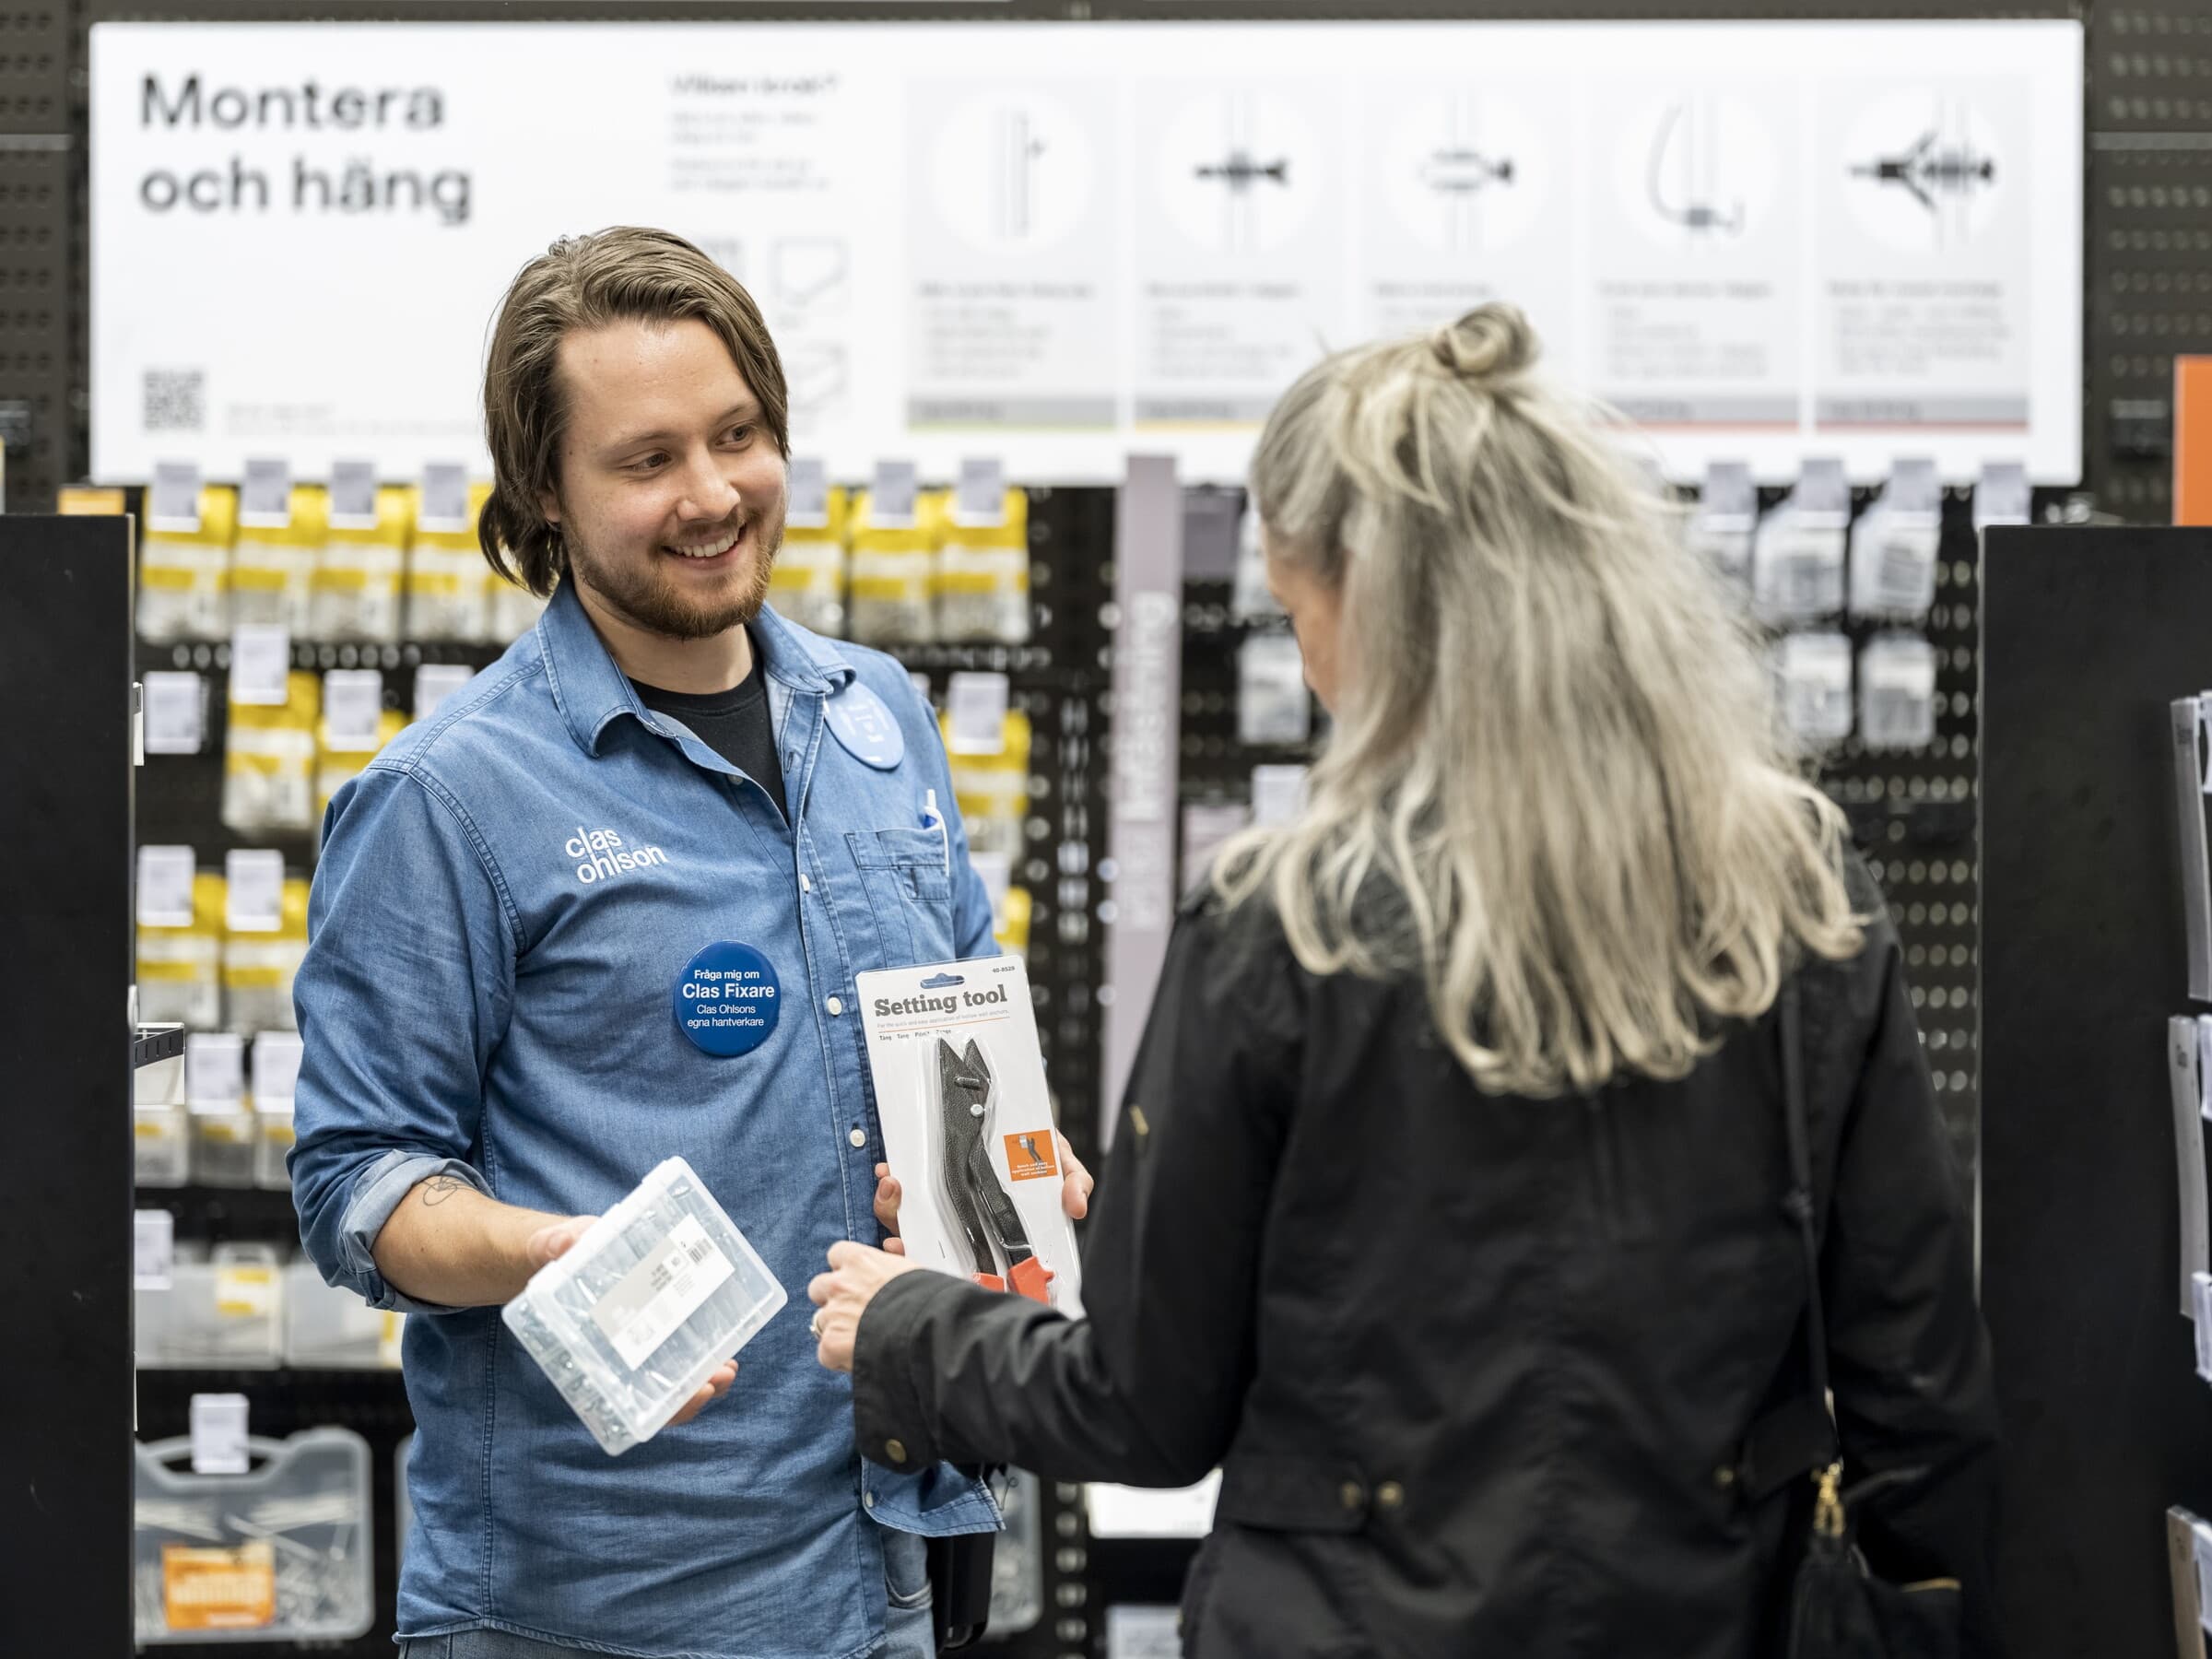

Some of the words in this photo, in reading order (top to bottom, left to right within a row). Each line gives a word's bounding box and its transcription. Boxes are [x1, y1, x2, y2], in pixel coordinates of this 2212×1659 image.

[141, 75, 444, 129] Montera
[140, 156, 269, 212] och
[292, 155, 470, 227] häng
[565, 826, 623, 858] clas
[577, 845, 669, 884] ohlson
[682, 983, 720, 998] Clas
[725, 983, 775, 997] Fixare
[694, 969, 722, 981] Fråga
[724, 970, 742, 981] mig
[697, 1004, 716, 1014] Clas
[719, 1004, 756, 1014] Ohlsons
[875, 994, 958, 1017] Setting
[963, 984, 1007, 1006] tool
[687, 1018, 710, 1029] egna
[712, 1018, 764, 1027] hantverkare
